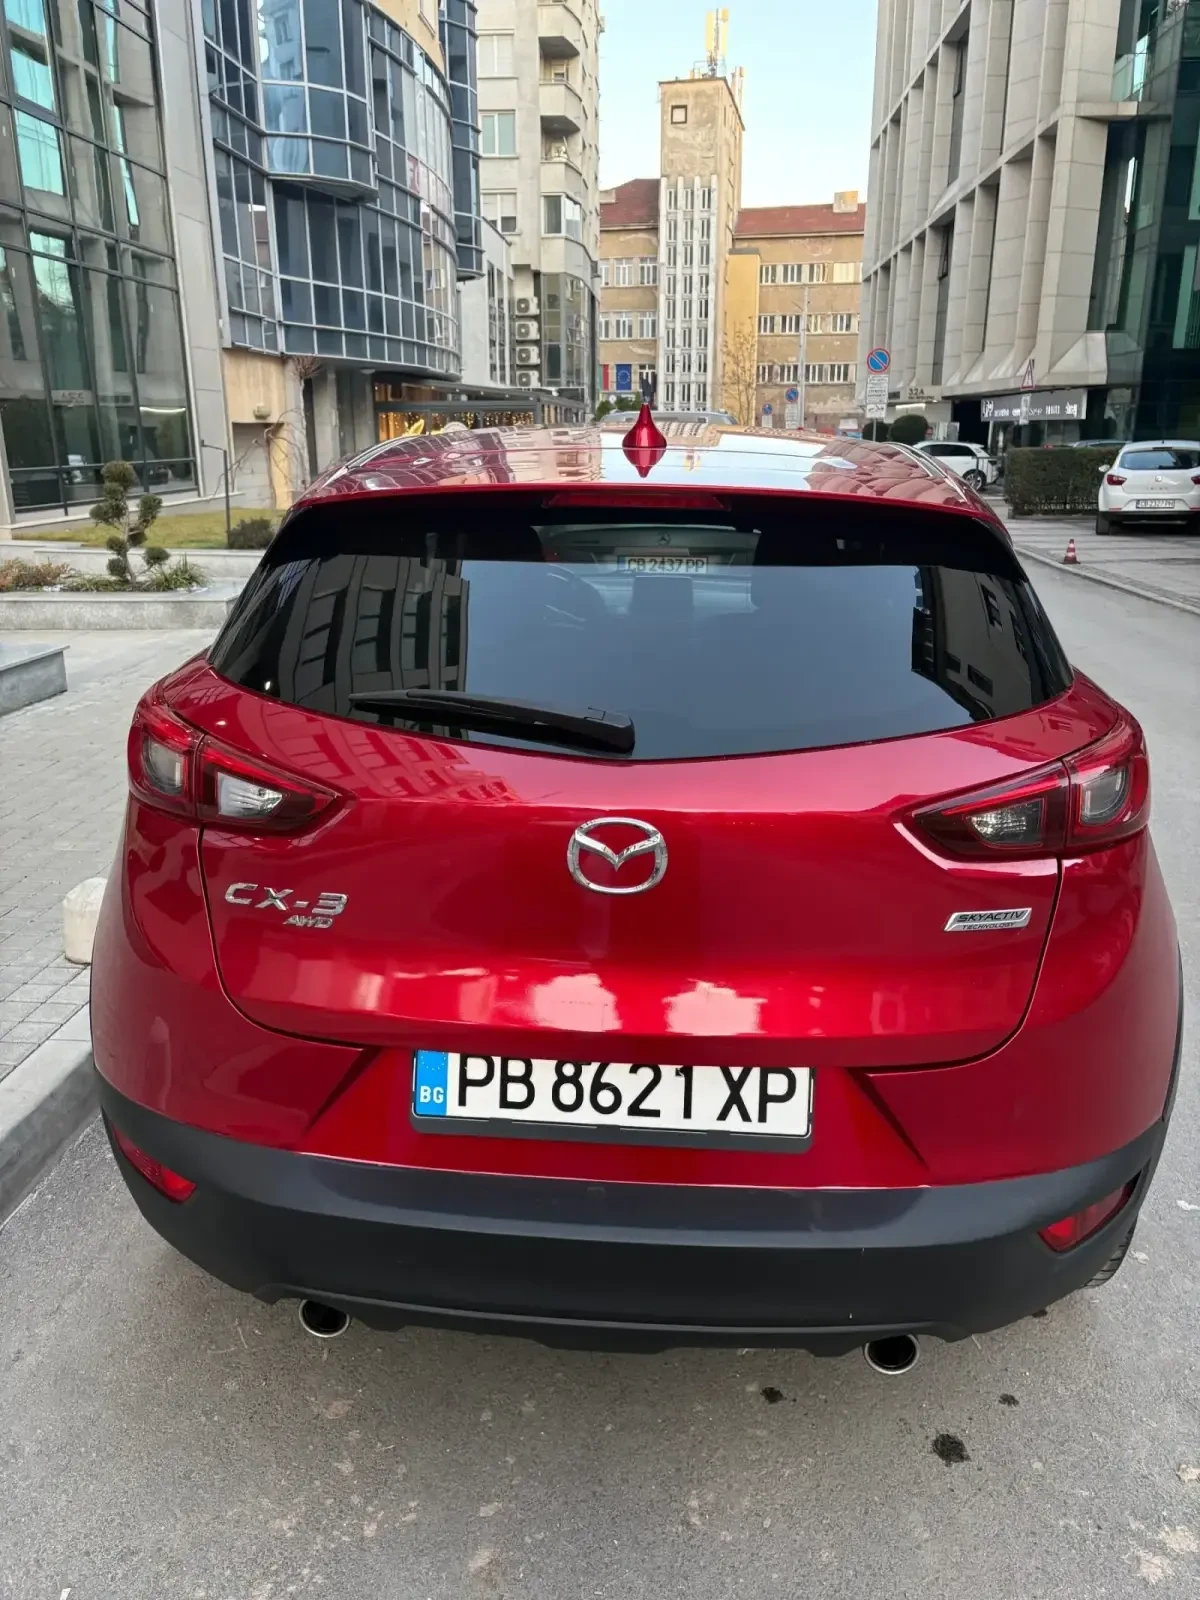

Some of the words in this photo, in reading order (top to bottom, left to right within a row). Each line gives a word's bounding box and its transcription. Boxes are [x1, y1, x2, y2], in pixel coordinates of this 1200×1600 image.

[627, 558, 645, 572] CB
[649, 558, 683, 572] 2437
[686, 559, 704, 572] PP
[225, 882, 348, 916] CX-3
[282, 914, 333, 929] AWD
[957, 911, 1024, 922] SKYACTIV
[963, 922, 1015, 930] TECHNOLOGY
[420, 1086, 444, 1103] BG
[458, 1053, 535, 1110] PB
[552, 1060, 693, 1119] 8621
[716, 1065, 797, 1123] XP
